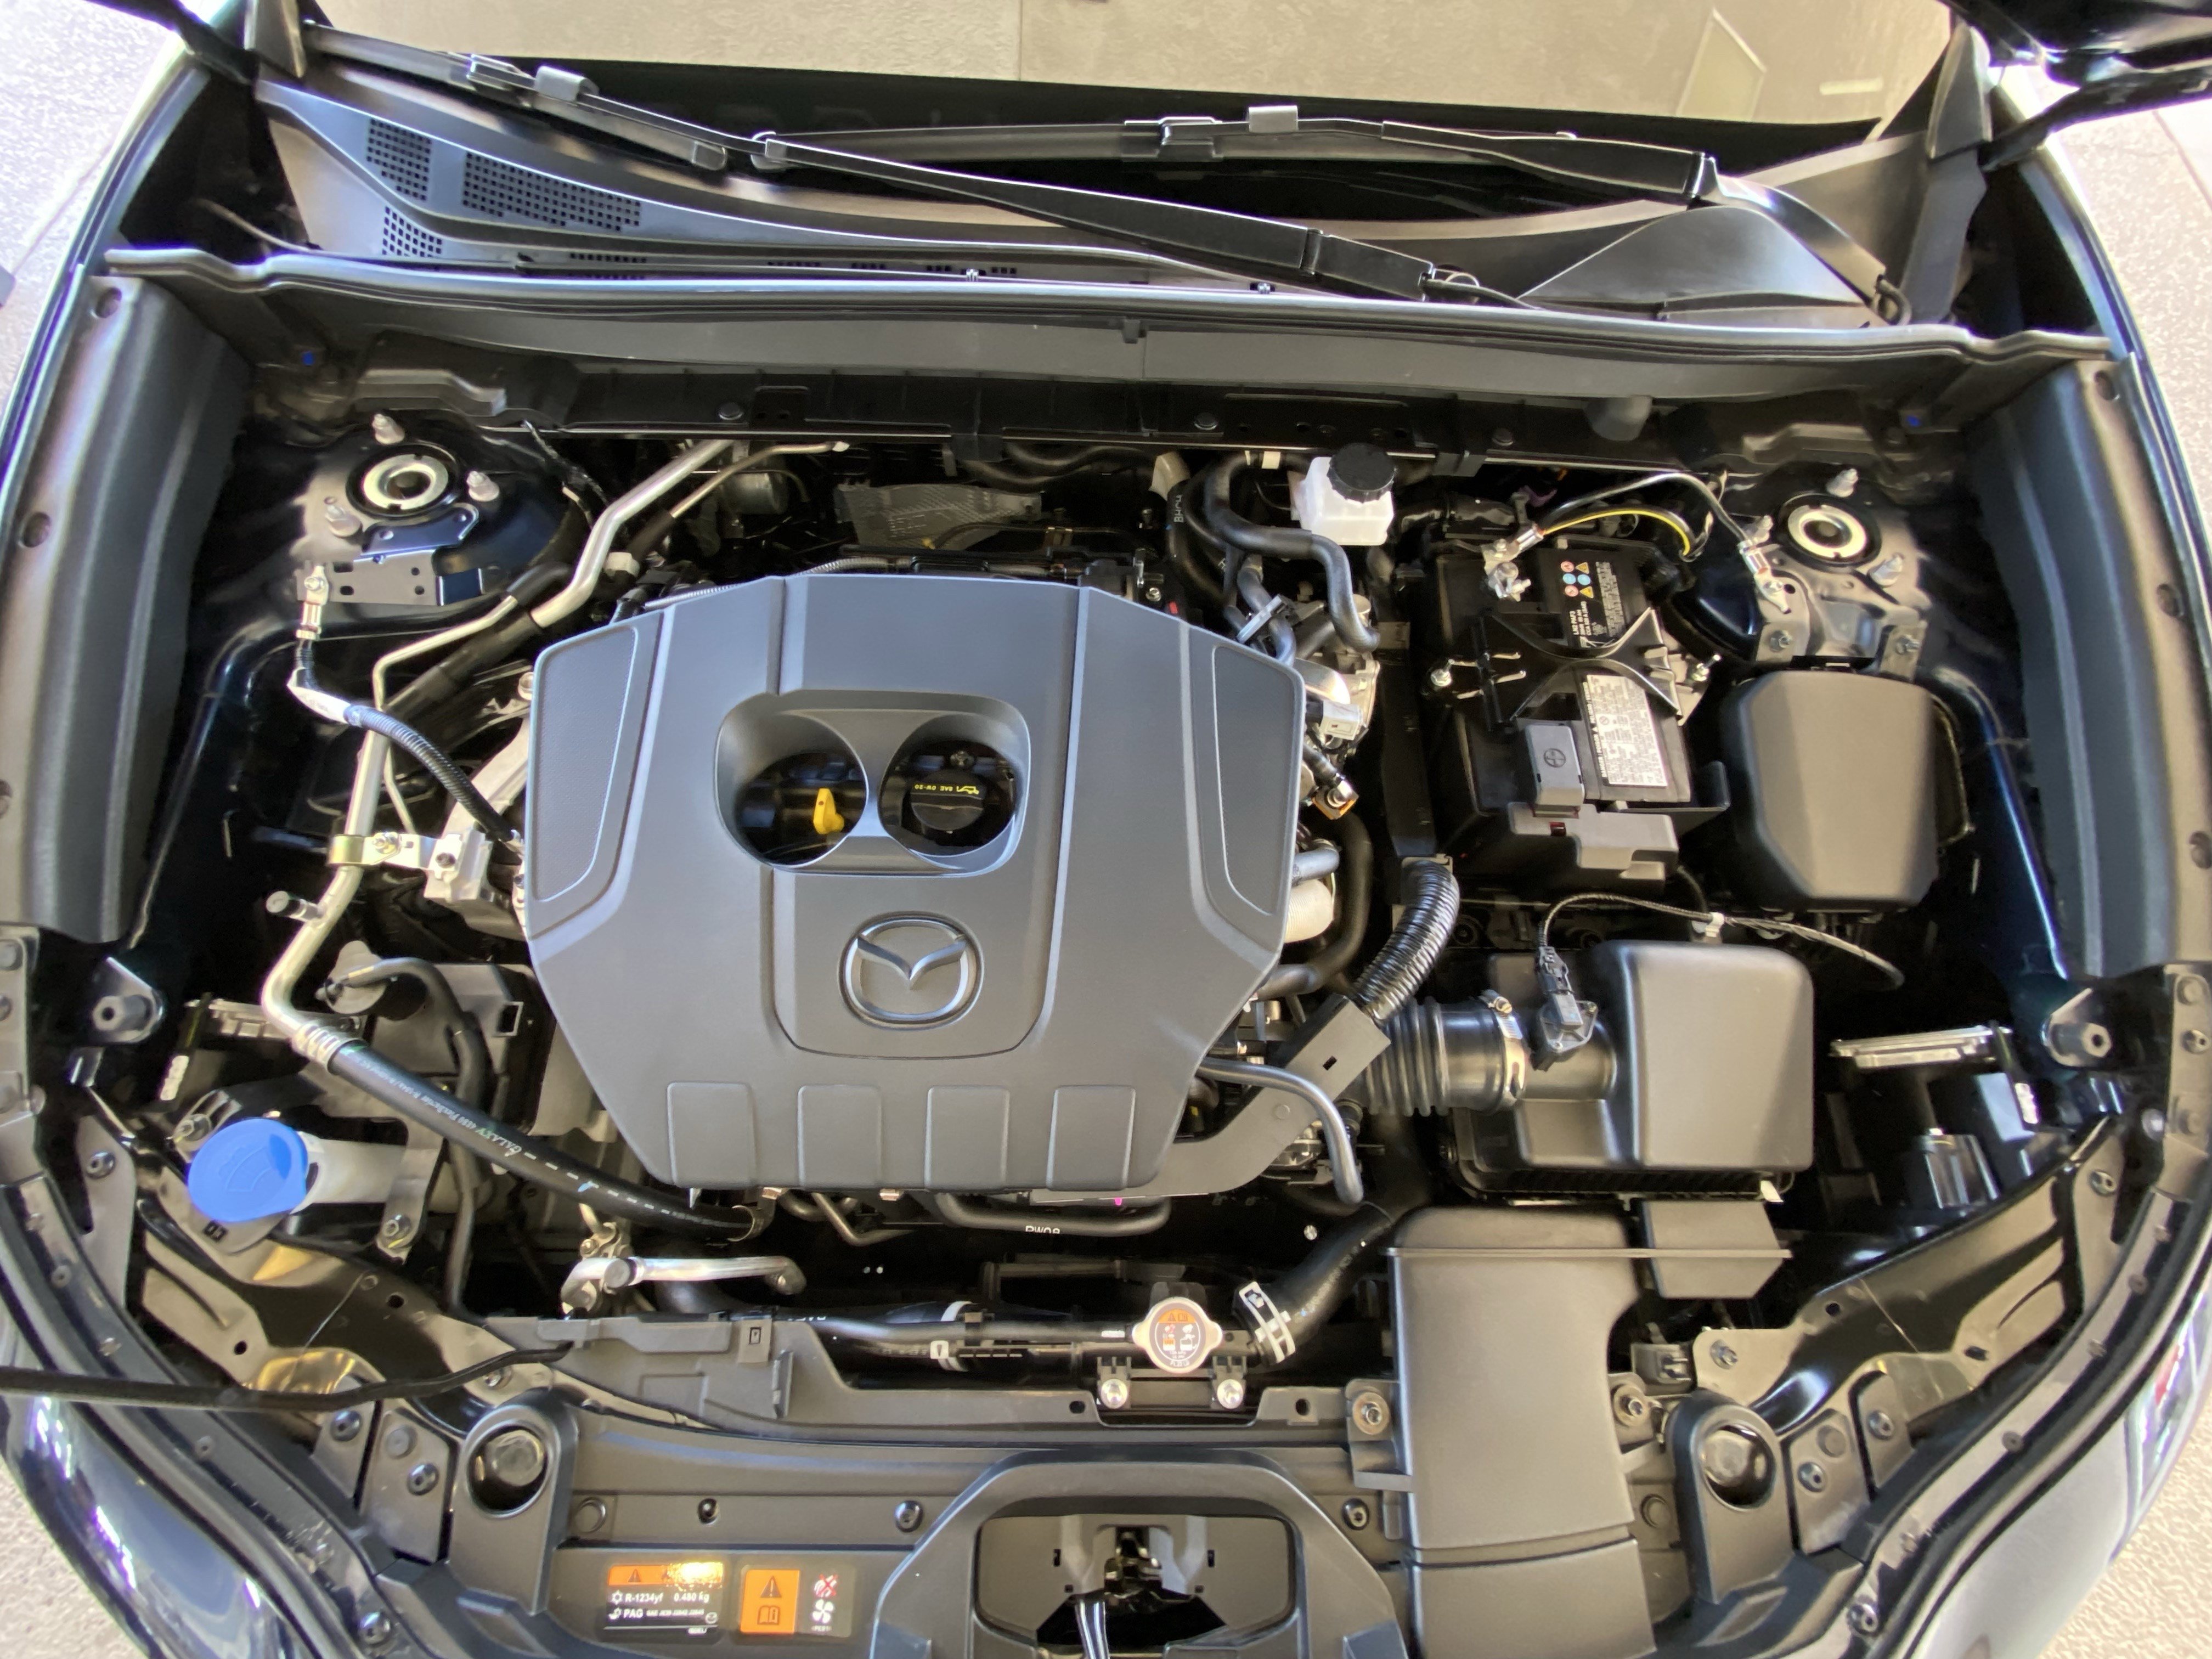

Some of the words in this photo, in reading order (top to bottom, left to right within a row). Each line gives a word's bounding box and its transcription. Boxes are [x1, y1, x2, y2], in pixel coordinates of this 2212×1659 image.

[625, 1592, 664, 1605] R-1234yf
[698, 1591, 710, 1604] kg
[623, 1608, 643, 1618] PAG
